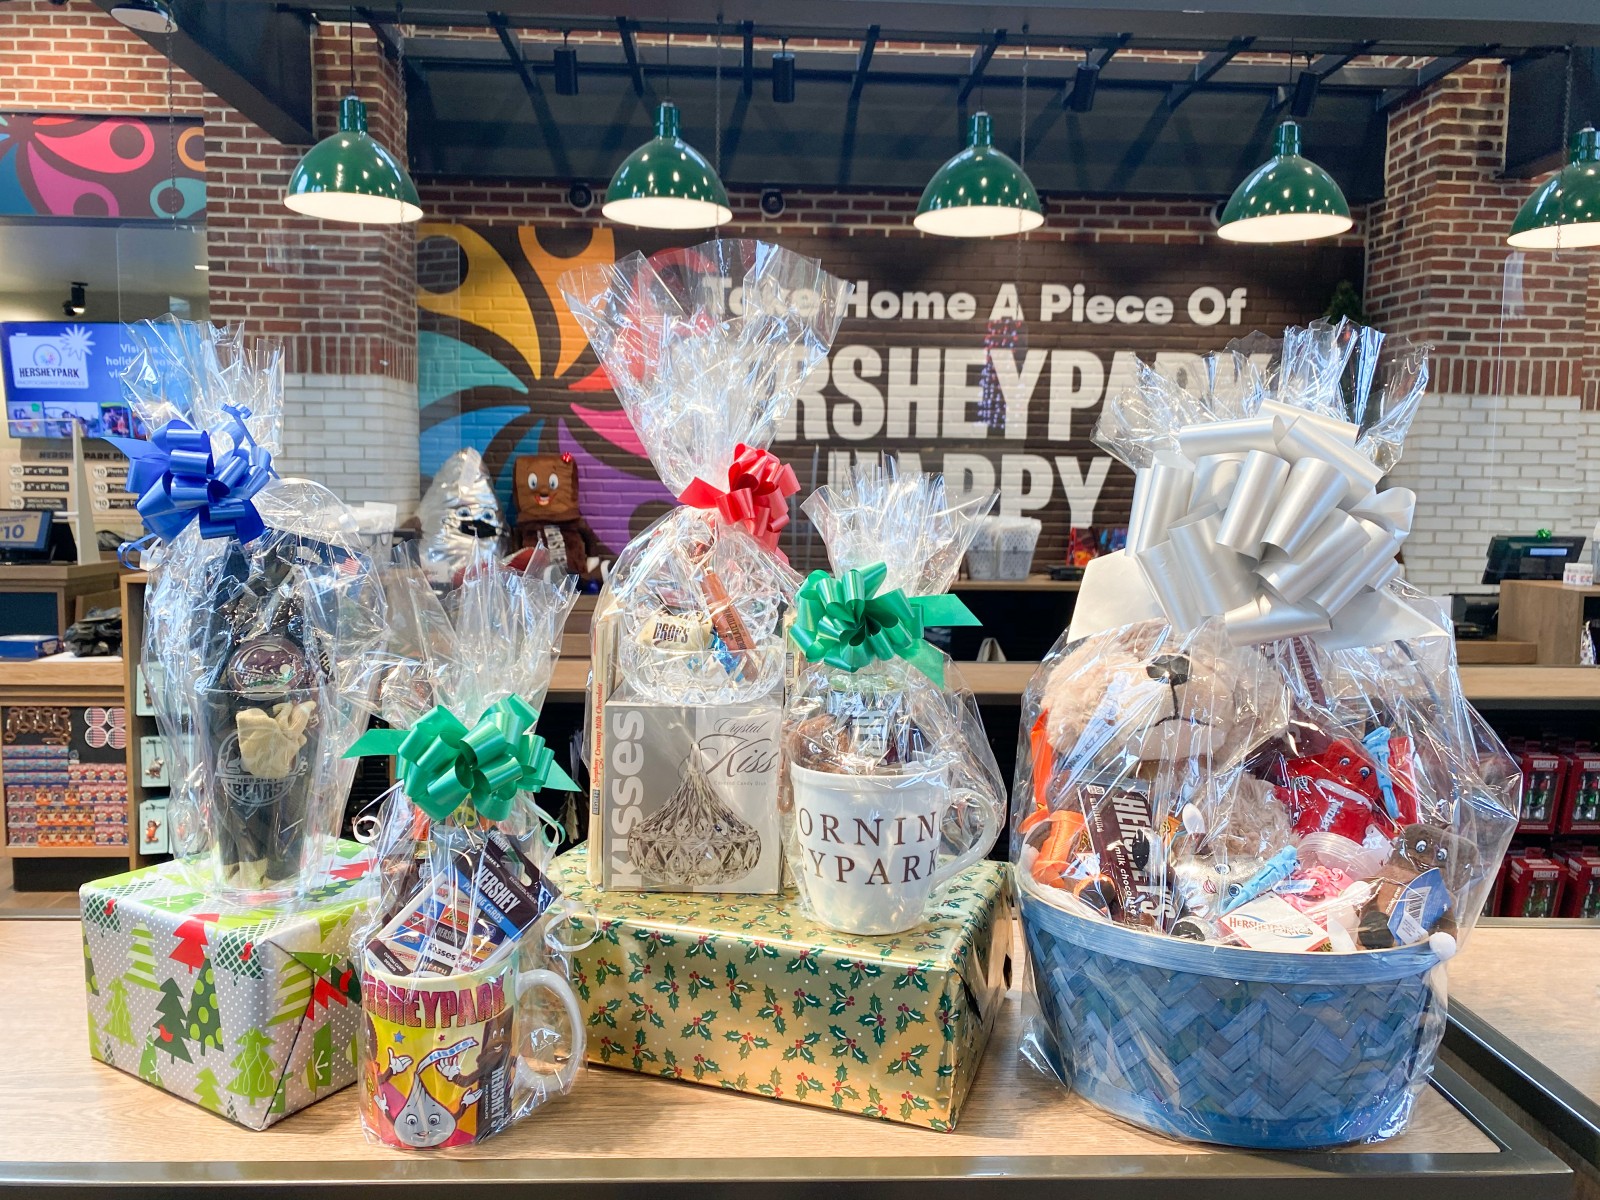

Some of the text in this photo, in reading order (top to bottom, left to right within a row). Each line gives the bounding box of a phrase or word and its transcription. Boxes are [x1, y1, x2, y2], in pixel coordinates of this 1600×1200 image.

[702, 276, 1247, 325] Take Home A Piece Of
[19, 367, 80, 379] HERSHEYPARK
[742, 342, 1275, 442] RSHEYPARK
[39, 452, 110, 460] HERSHPARK
[595, 683, 603, 714] Chocolate
[595, 731, 604, 755] Creamy
[714, 717, 770, 736] Crystal
[698, 733, 779, 778] Kiss
[232, 782, 284, 800] BEARS
[799, 807, 937, 847] ORNIN
[1111, 796, 1176, 919] HERY'S
[1114, 846, 1126, 866] milk
[463, 882, 487, 907] PLING
[482, 901, 505, 923] CARDS
[474, 865, 521, 914] HERSHEY
